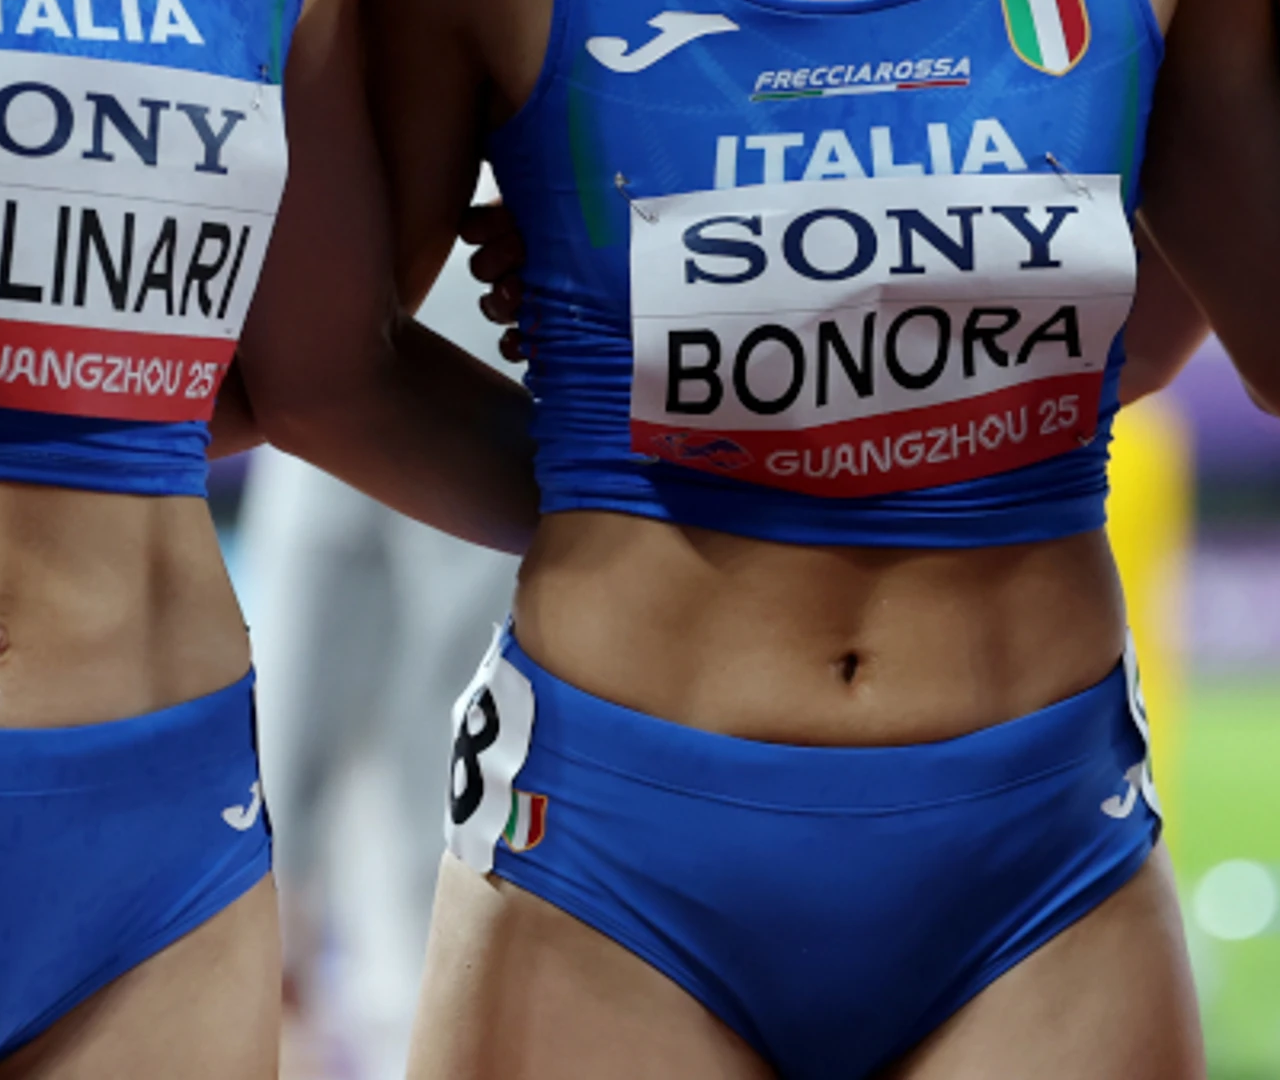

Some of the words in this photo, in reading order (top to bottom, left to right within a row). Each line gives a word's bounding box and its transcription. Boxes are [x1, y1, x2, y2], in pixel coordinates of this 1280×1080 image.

[753, 56, 971, 91] FRECCIAROSSA
[713, 117, 1028, 189] ITALIA
[681, 205, 1078, 285] SONY
[184, 361, 218, 399] 25
[664, 305, 1082, 416] BONORA
[764, 406, 1029, 479] GUANGZHOU
[1038, 394, 1079, 437] 25
[450, 683, 500, 826] 8
